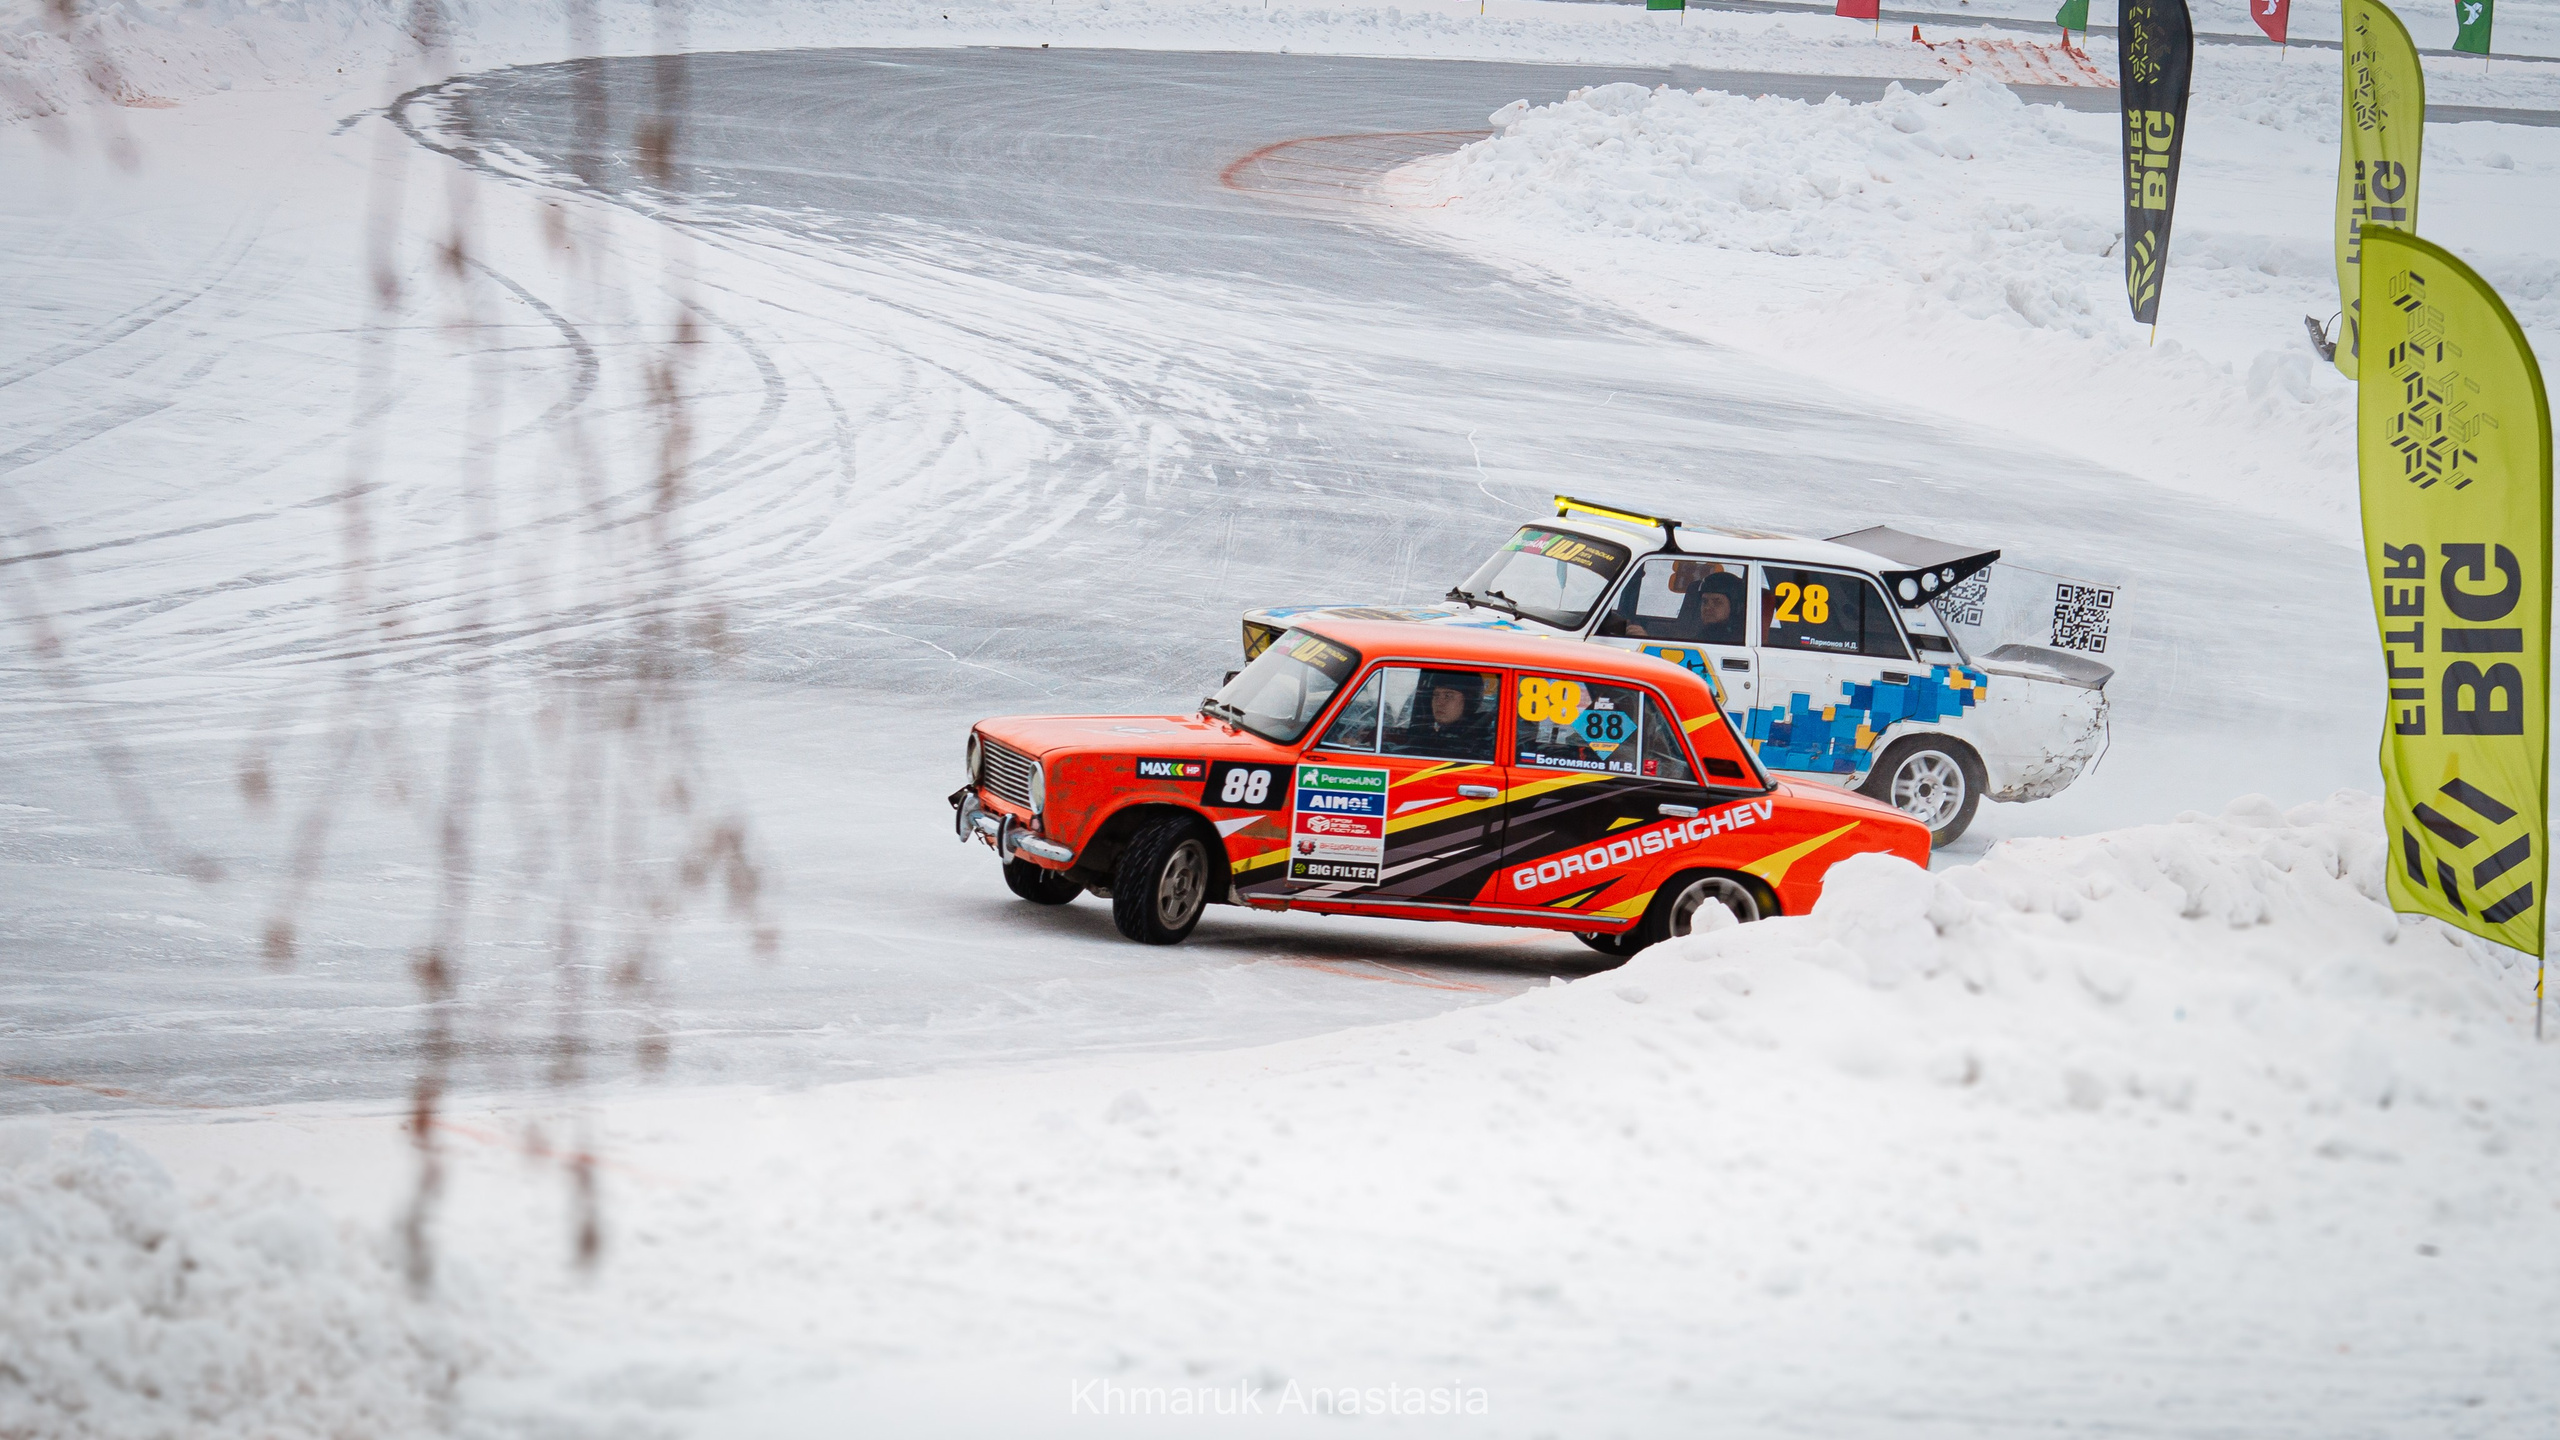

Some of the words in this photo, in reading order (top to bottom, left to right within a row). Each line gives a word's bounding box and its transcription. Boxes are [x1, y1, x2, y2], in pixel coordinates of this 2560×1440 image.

[1775, 582, 1829, 624] 28
[1518, 677, 1581, 725] 88
[1586, 713, 1623, 740] 88
[1140, 761, 1172, 776] MAX
[1186, 766, 1201, 774] HP
[1536, 754, 1606, 770] Богомяков
[1608, 760, 1638, 773] М.В.
[1221, 768, 1272, 804] 88
[1513, 799, 1773, 891] GORODISHCHEV
[1308, 863, 1331, 876] BIG
[1332, 865, 1377, 879] FILTER
